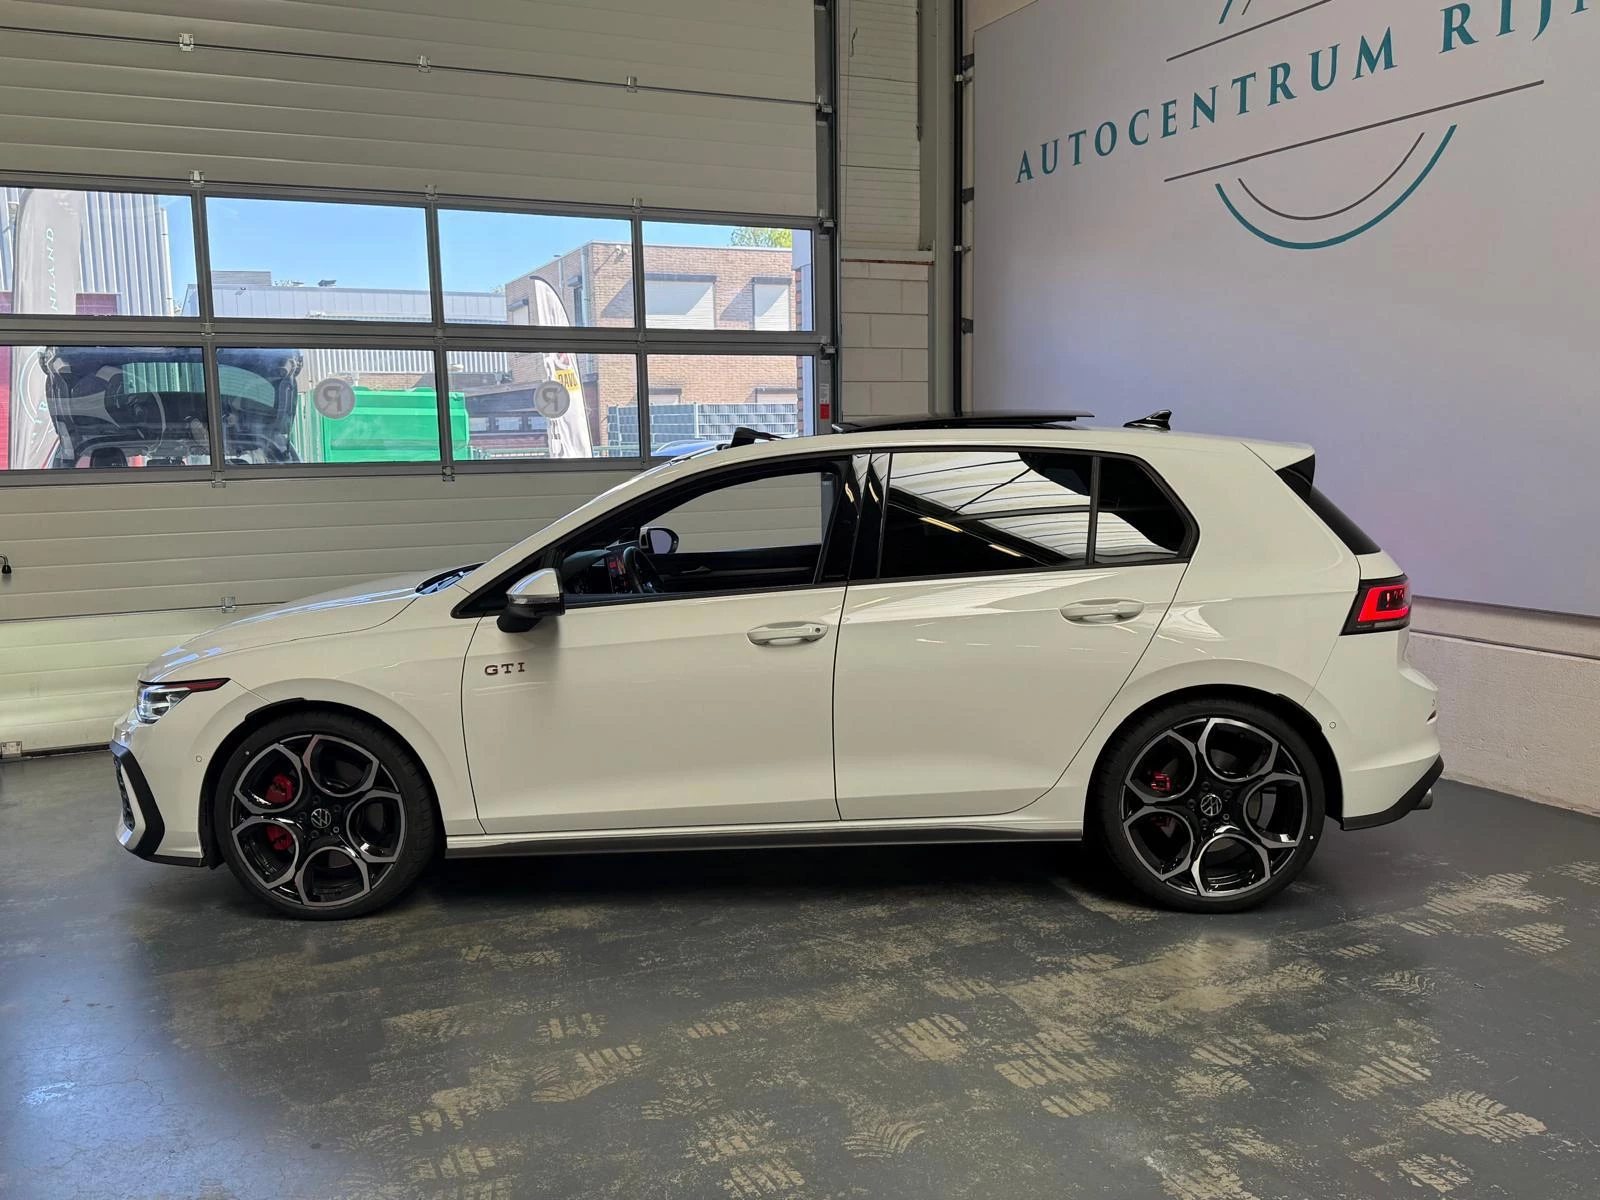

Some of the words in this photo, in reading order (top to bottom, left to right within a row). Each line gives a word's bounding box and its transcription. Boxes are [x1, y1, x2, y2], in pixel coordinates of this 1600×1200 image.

[1015, 26, 1398, 184] AUTOCENTRUM
[1438, 0, 1590, 54] RIJ
[46, 227, 58, 312] NLAND
[484, 662, 526, 676] GTI
